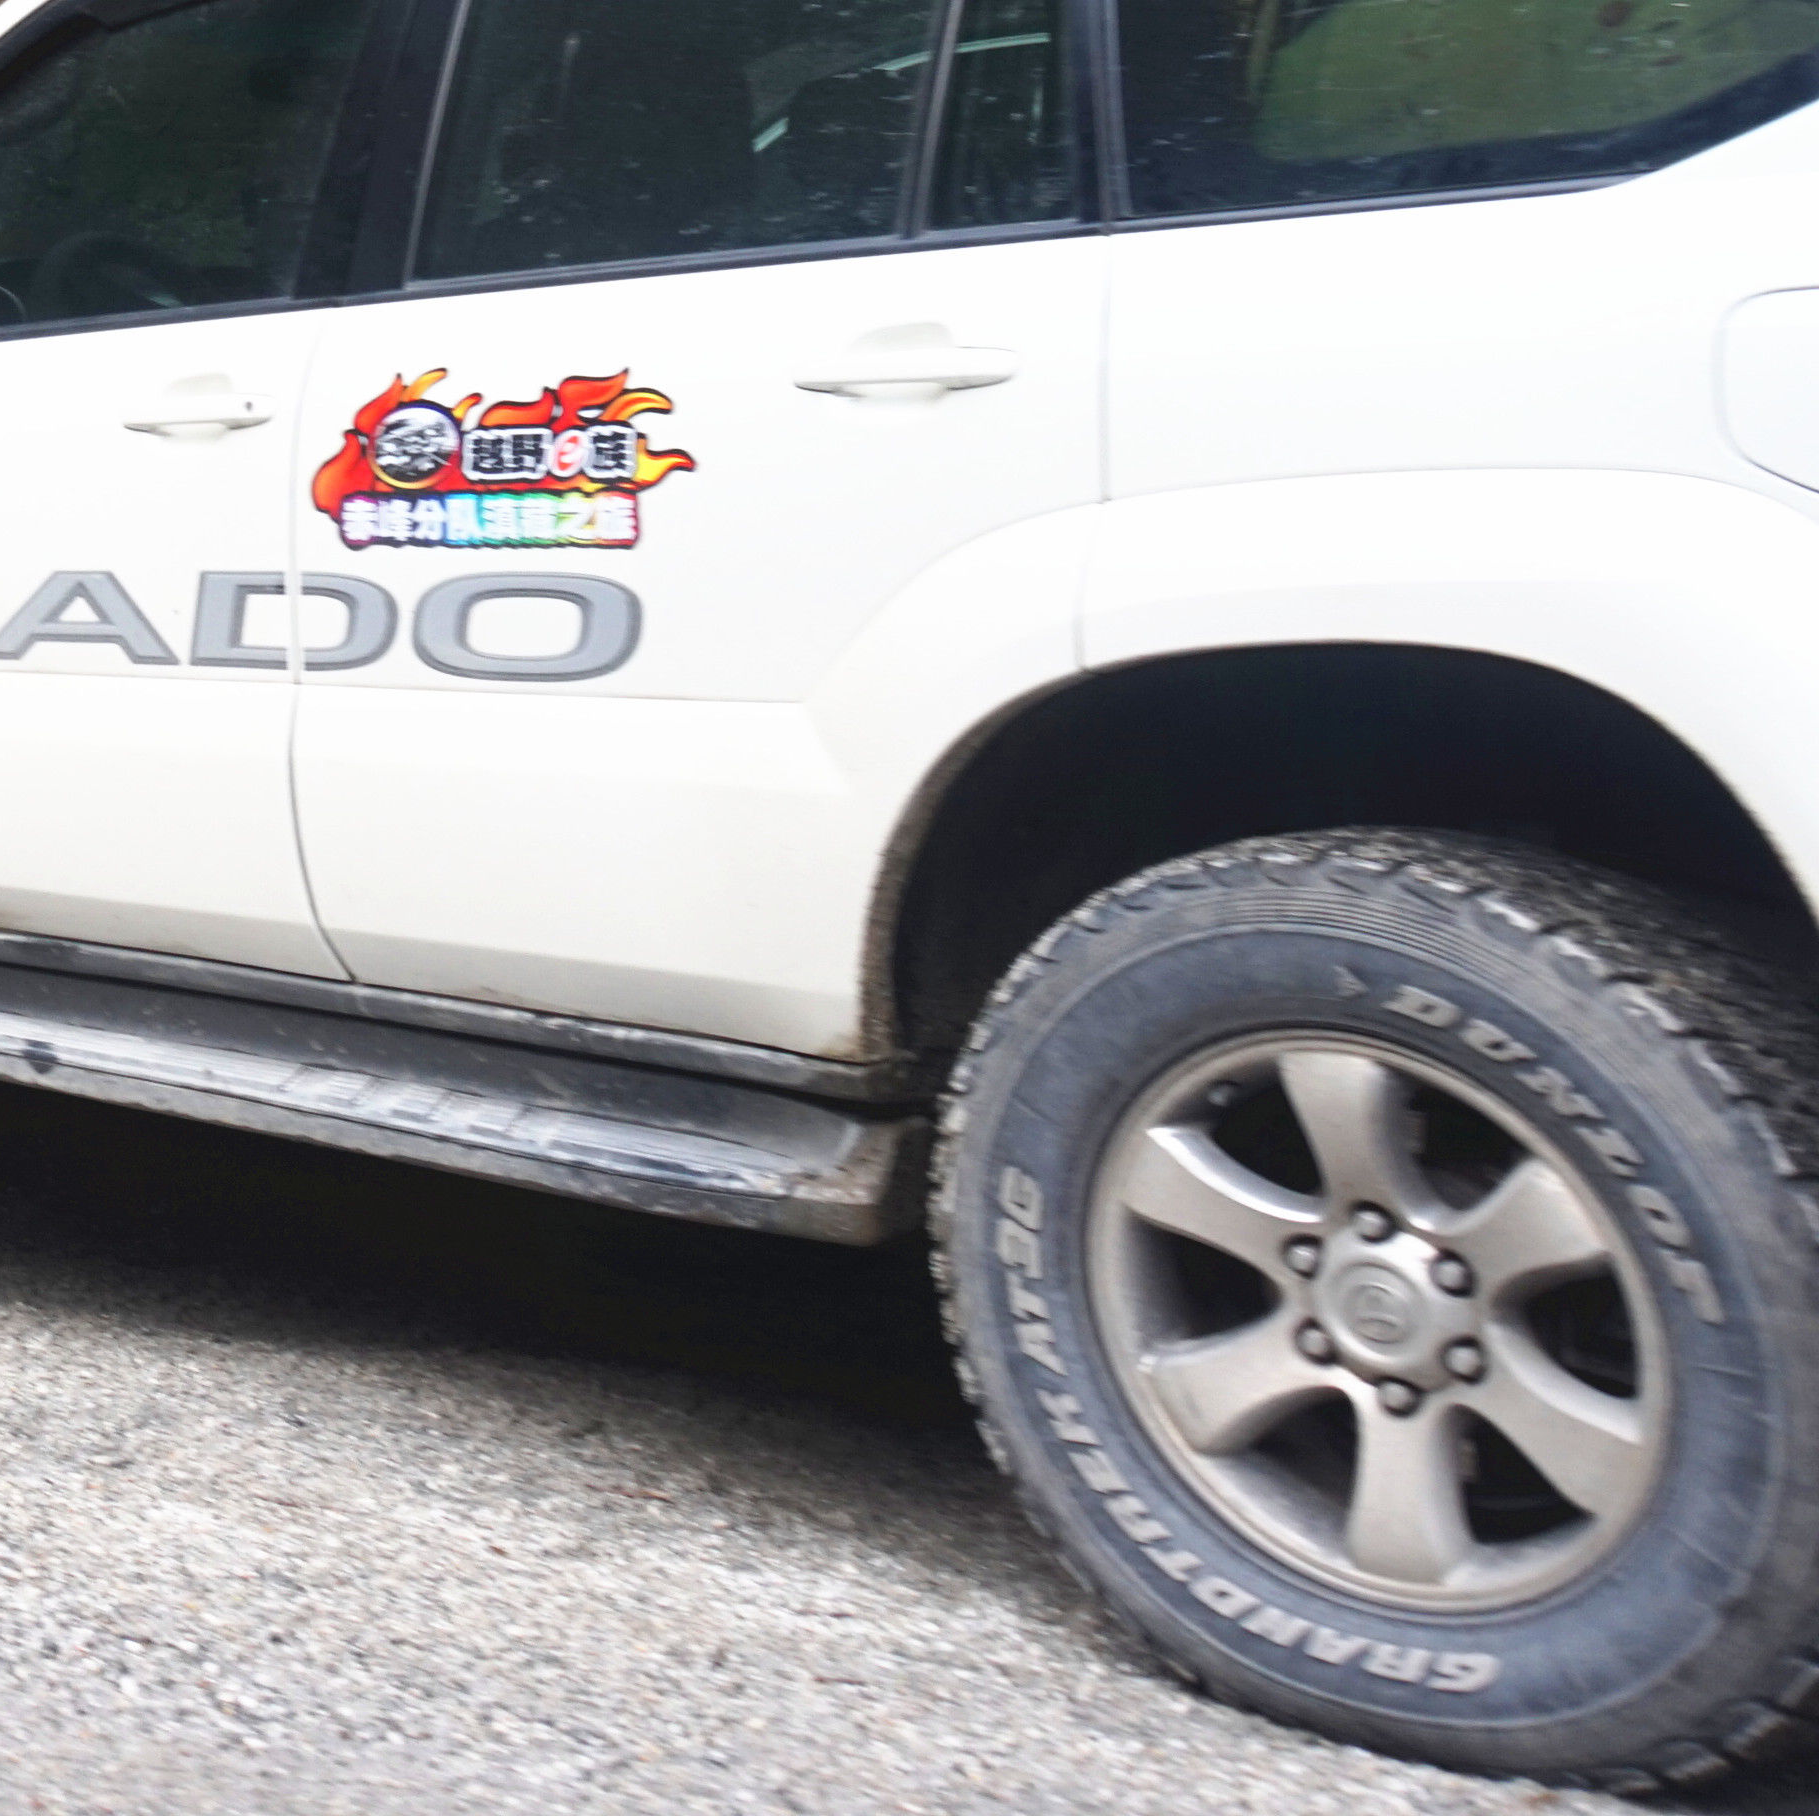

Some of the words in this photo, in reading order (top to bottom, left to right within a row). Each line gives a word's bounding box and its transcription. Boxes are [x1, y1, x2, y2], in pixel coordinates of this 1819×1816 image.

[469, 427, 633, 477] 越野e族
[1380, 985, 1725, 1325] DUNLOP
[1039, 1388, 1501, 1695] GRANDTREK
